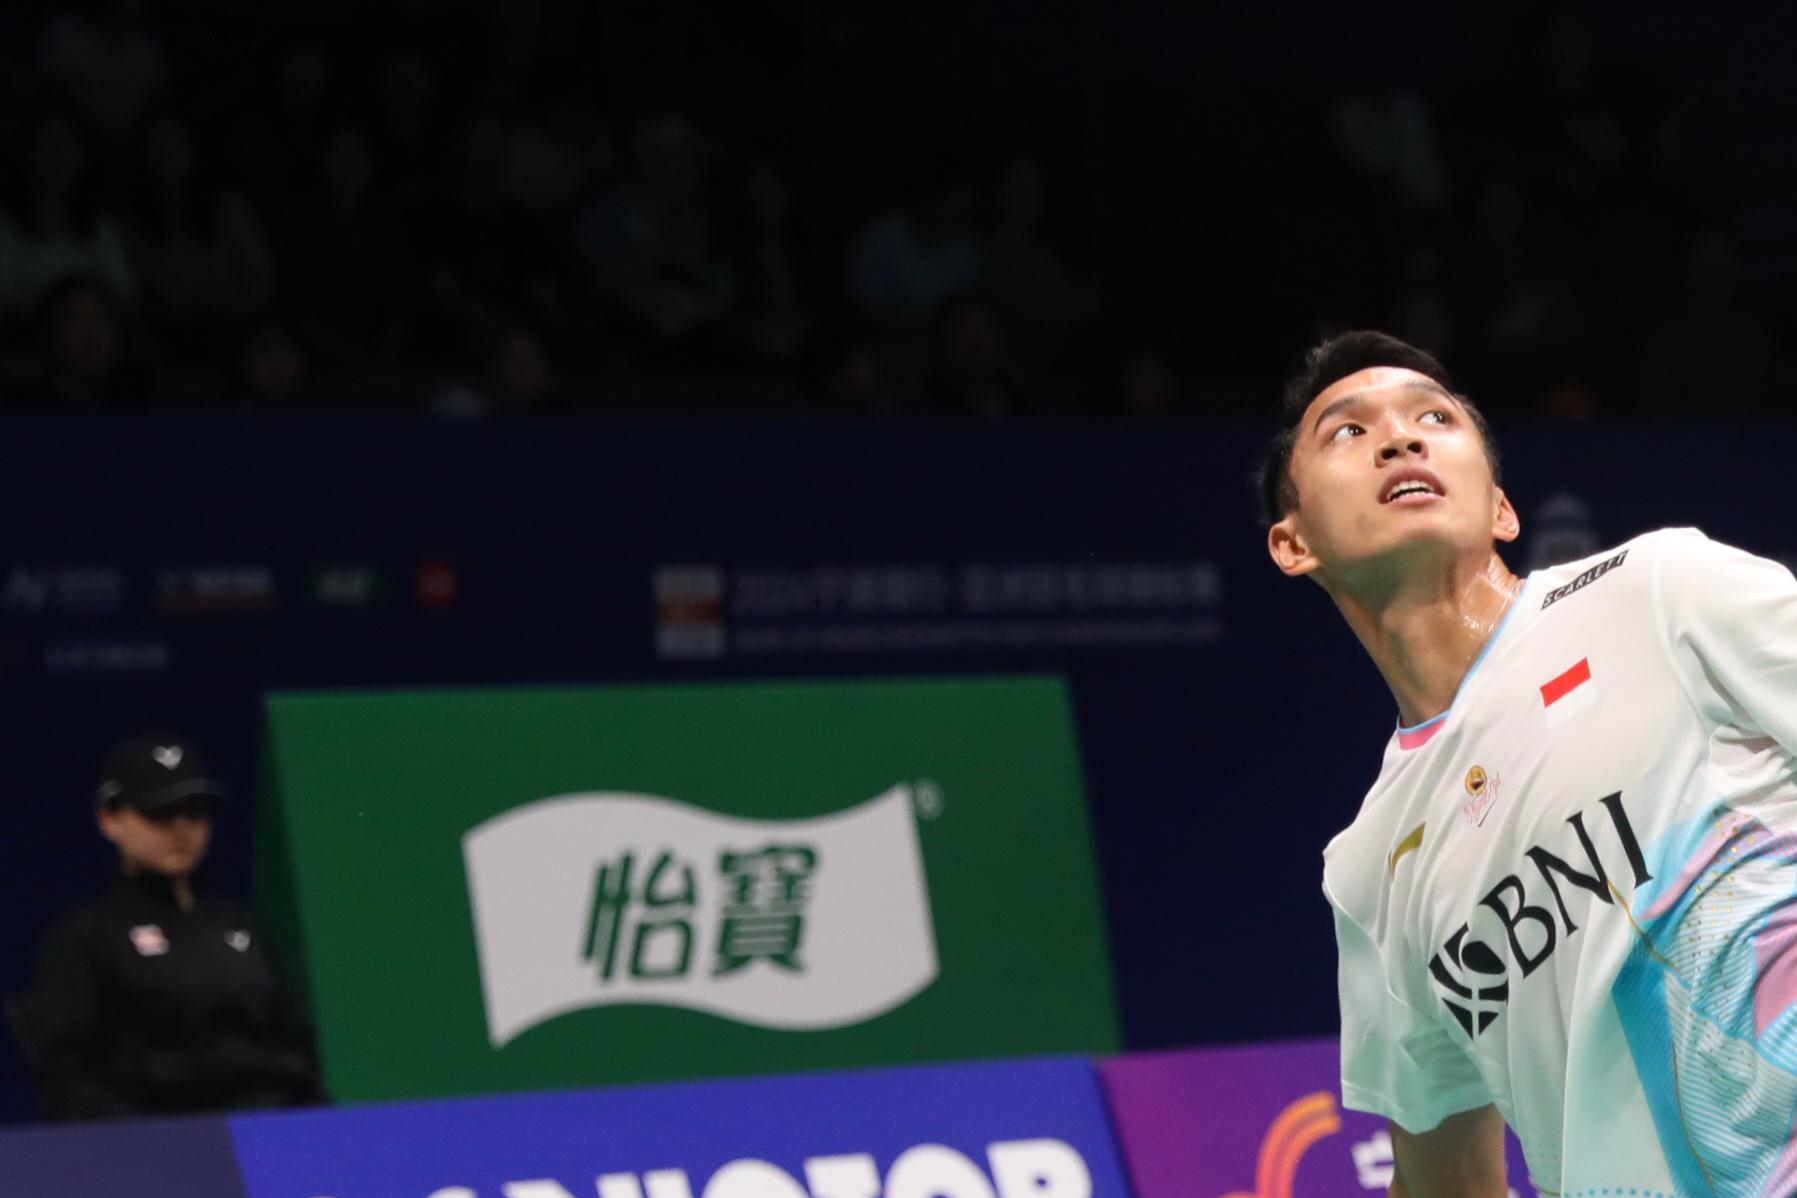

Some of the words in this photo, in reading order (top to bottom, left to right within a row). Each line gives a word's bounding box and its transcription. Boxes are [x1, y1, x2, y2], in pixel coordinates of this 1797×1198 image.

[1542, 551, 1627, 609] SCARLETT
[580, 844, 818, 984] 怡寶
[1478, 790, 1653, 979] BNI
